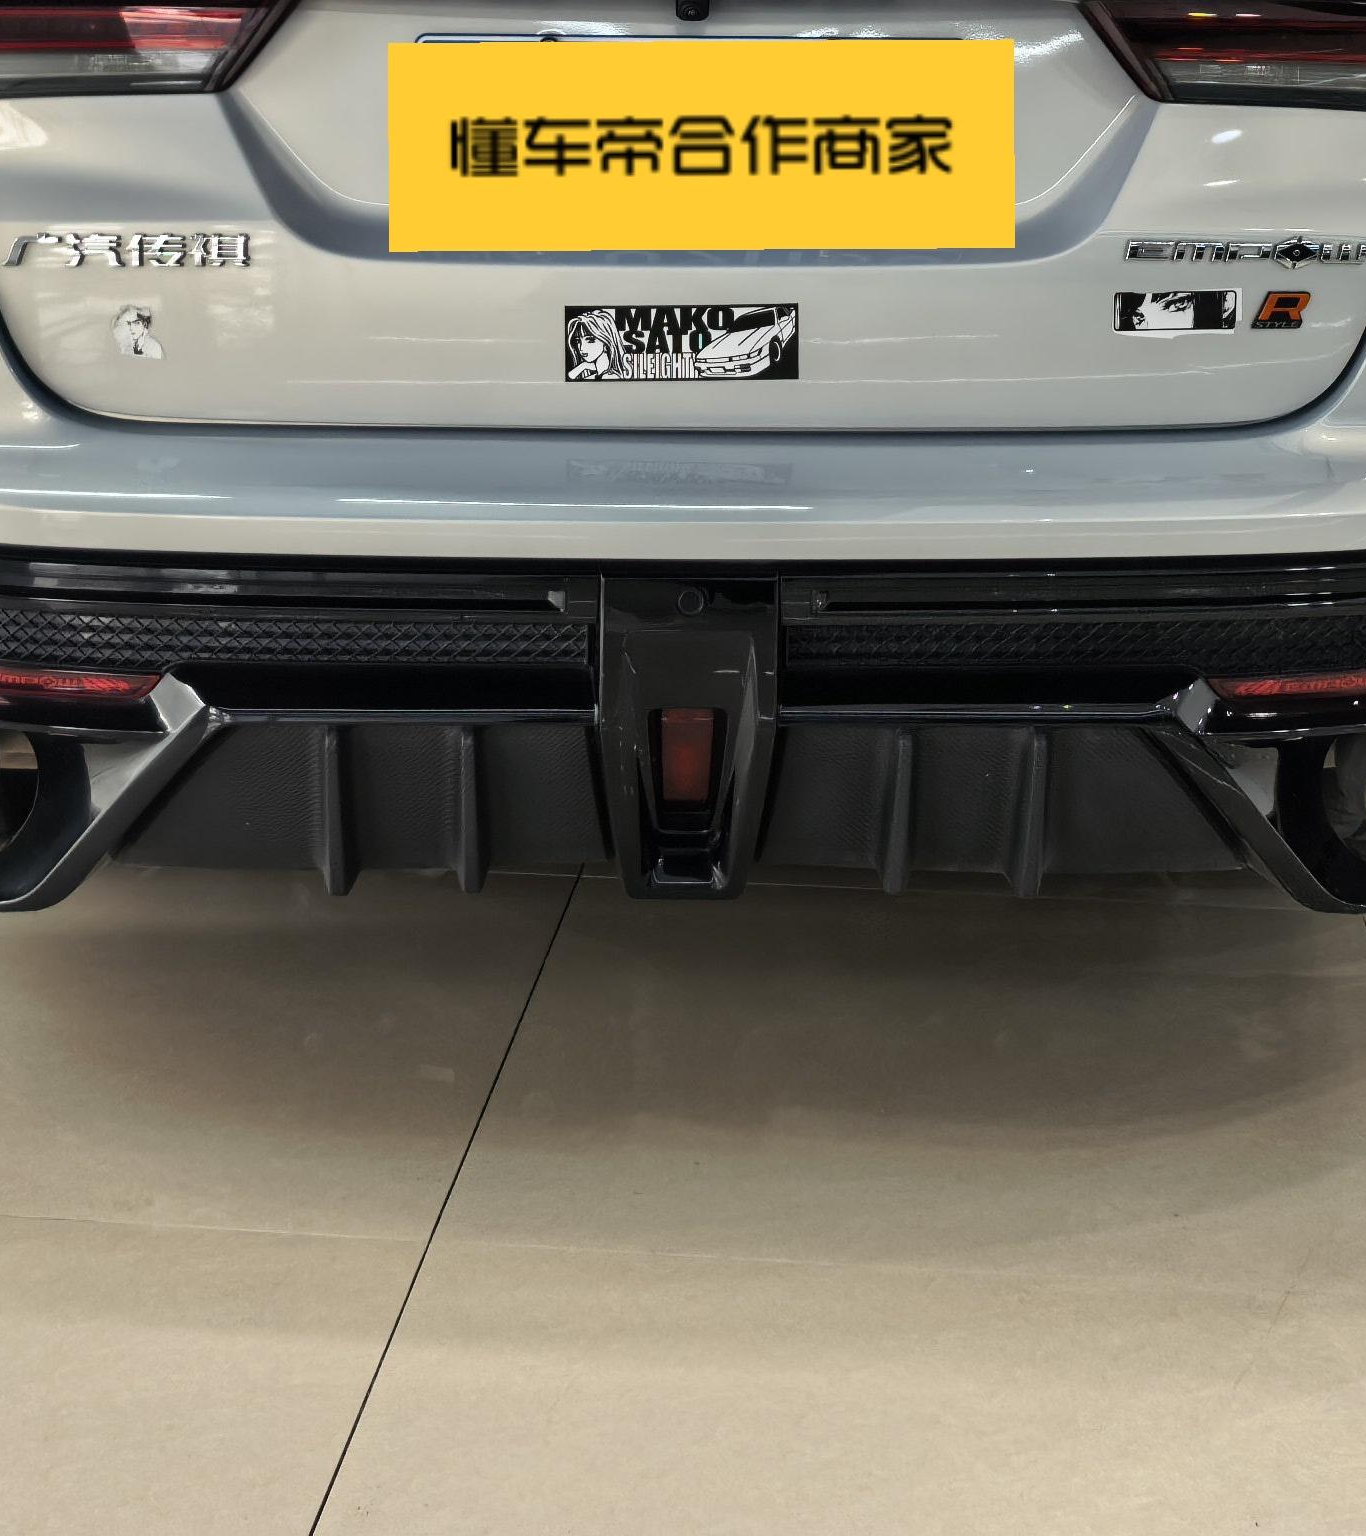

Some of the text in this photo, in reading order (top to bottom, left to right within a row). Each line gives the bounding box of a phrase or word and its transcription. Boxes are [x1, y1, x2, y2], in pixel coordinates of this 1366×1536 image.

[2, 232, 251, 267] 广汽传祺
[1257, 293, 1311, 320] R
[614, 306, 735, 335] MAKO
[1253, 320, 1300, 329] STYLE
[622, 330, 712, 355] SATO
